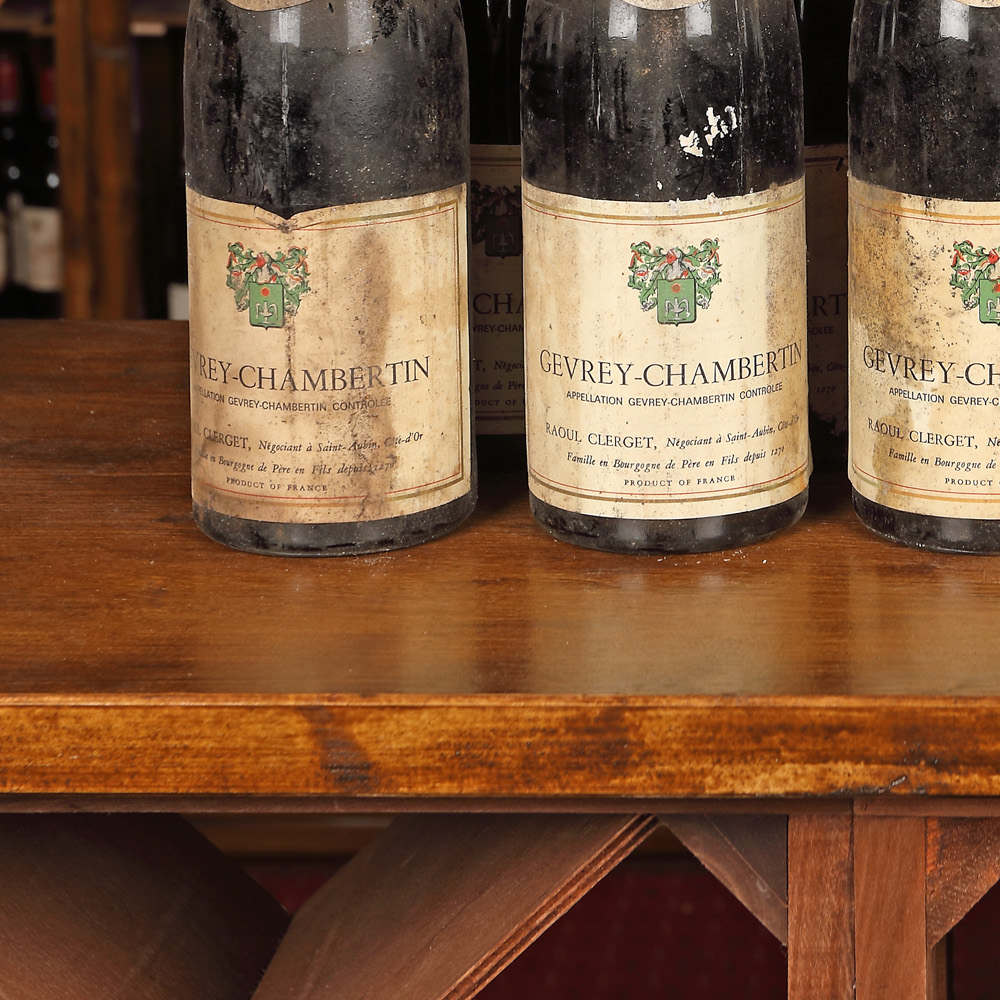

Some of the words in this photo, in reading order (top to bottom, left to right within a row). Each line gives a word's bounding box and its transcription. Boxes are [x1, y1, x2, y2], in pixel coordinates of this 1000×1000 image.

[539, 339, 803, 387] GEVREY-CHAMBERTIN
[228, 396, 327, 412] GEVREY-CHAMBERTIN
[566, 390, 623, 405] APPELLATION
[628, 393, 735, 407] GEVREY-CHAMBERTIN
[889, 387, 945, 404] APPELLATION
[203, 427, 252, 451] CLERGET,
[258, 440, 302, 454] Négociant
[306, 442, 312, 452] à
[545, 422, 582, 443] RAOUL
[587, 432, 657, 450] CLERGET,
[665, 437, 713, 450] Négociant
[716, 434, 722, 444] à
[725, 425, 776, 443] Saint-Aubin,
[867, 417, 904, 440] RAOUL
[909, 430, 978, 449] CLERGET,
[218, 455, 254, 473] Bourgogne
[258, 461, 267, 473] de
[272, 463, 290, 474] Père
[312, 464, 331, 475] Fils
[567, 452, 596, 466] Famille
[599, 459, 608, 467] en
[613, 458, 661, 472] Bourgogne
[665, 459, 676, 470] de
[681, 459, 701, 469] Père
[721, 454, 739, 466] Fils
[743, 450, 767, 464] depuis
[888, 448, 917, 463] Famille
[920, 456, 929, 464] en
[934, 457, 982, 472] Bourgogne
[986, 459, 997, 469] de
[226, 477, 264, 489] PRODUCT
[270, 483, 281, 491] OF
[287, 484, 327, 492] FRANCE
[624, 479, 673, 487] PRODUCT
[678, 479, 691, 487] OF
[697, 475, 735, 485] FRANCE
[944, 477, 993, 487] PRODUCT
